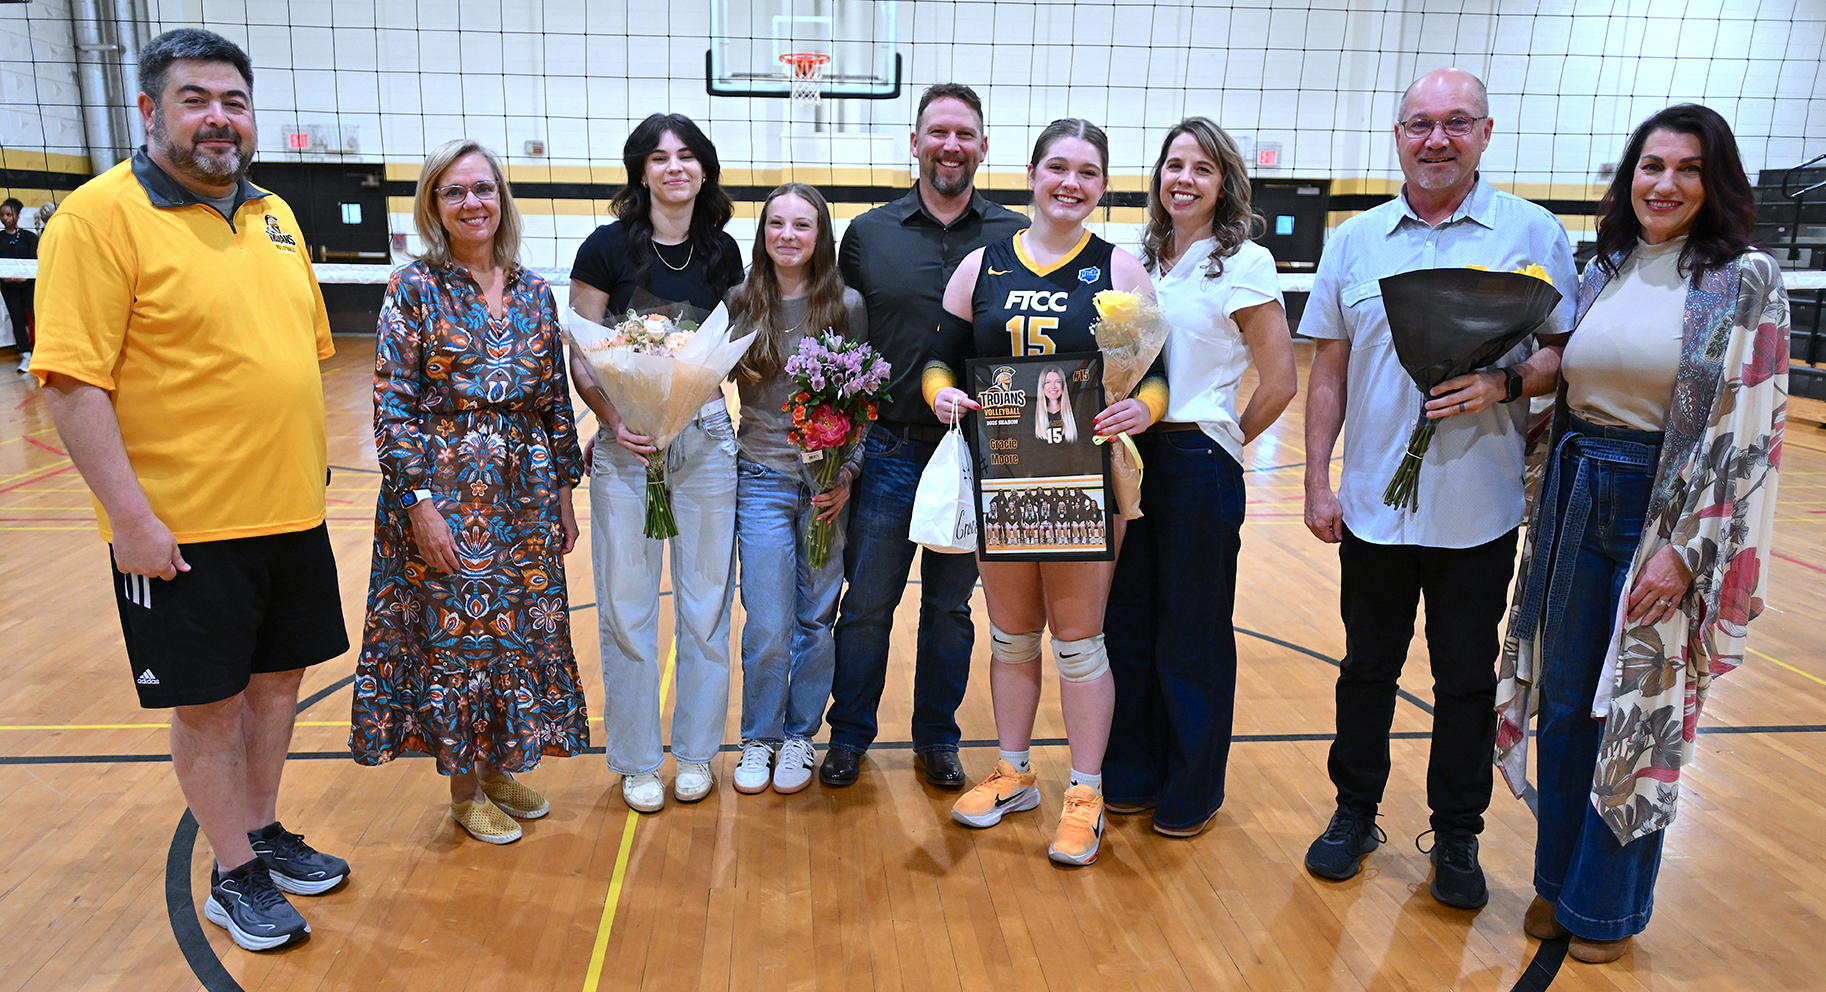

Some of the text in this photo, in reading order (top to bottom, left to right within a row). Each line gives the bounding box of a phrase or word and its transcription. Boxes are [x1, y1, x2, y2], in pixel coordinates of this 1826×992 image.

[290, 134, 308, 148] EXIT
[1259, 150, 1276, 165] EXIT
[1004, 291, 1068, 312] FTCC
[1006, 315, 1059, 357] 15
[979, 390, 1026, 407] TROJANS
[984, 407, 1021, 416] VOLLEYBALL
[1045, 427, 1063, 444] 15
[990, 438, 1018, 450] Gracie
[990, 453, 1019, 465] Moore
